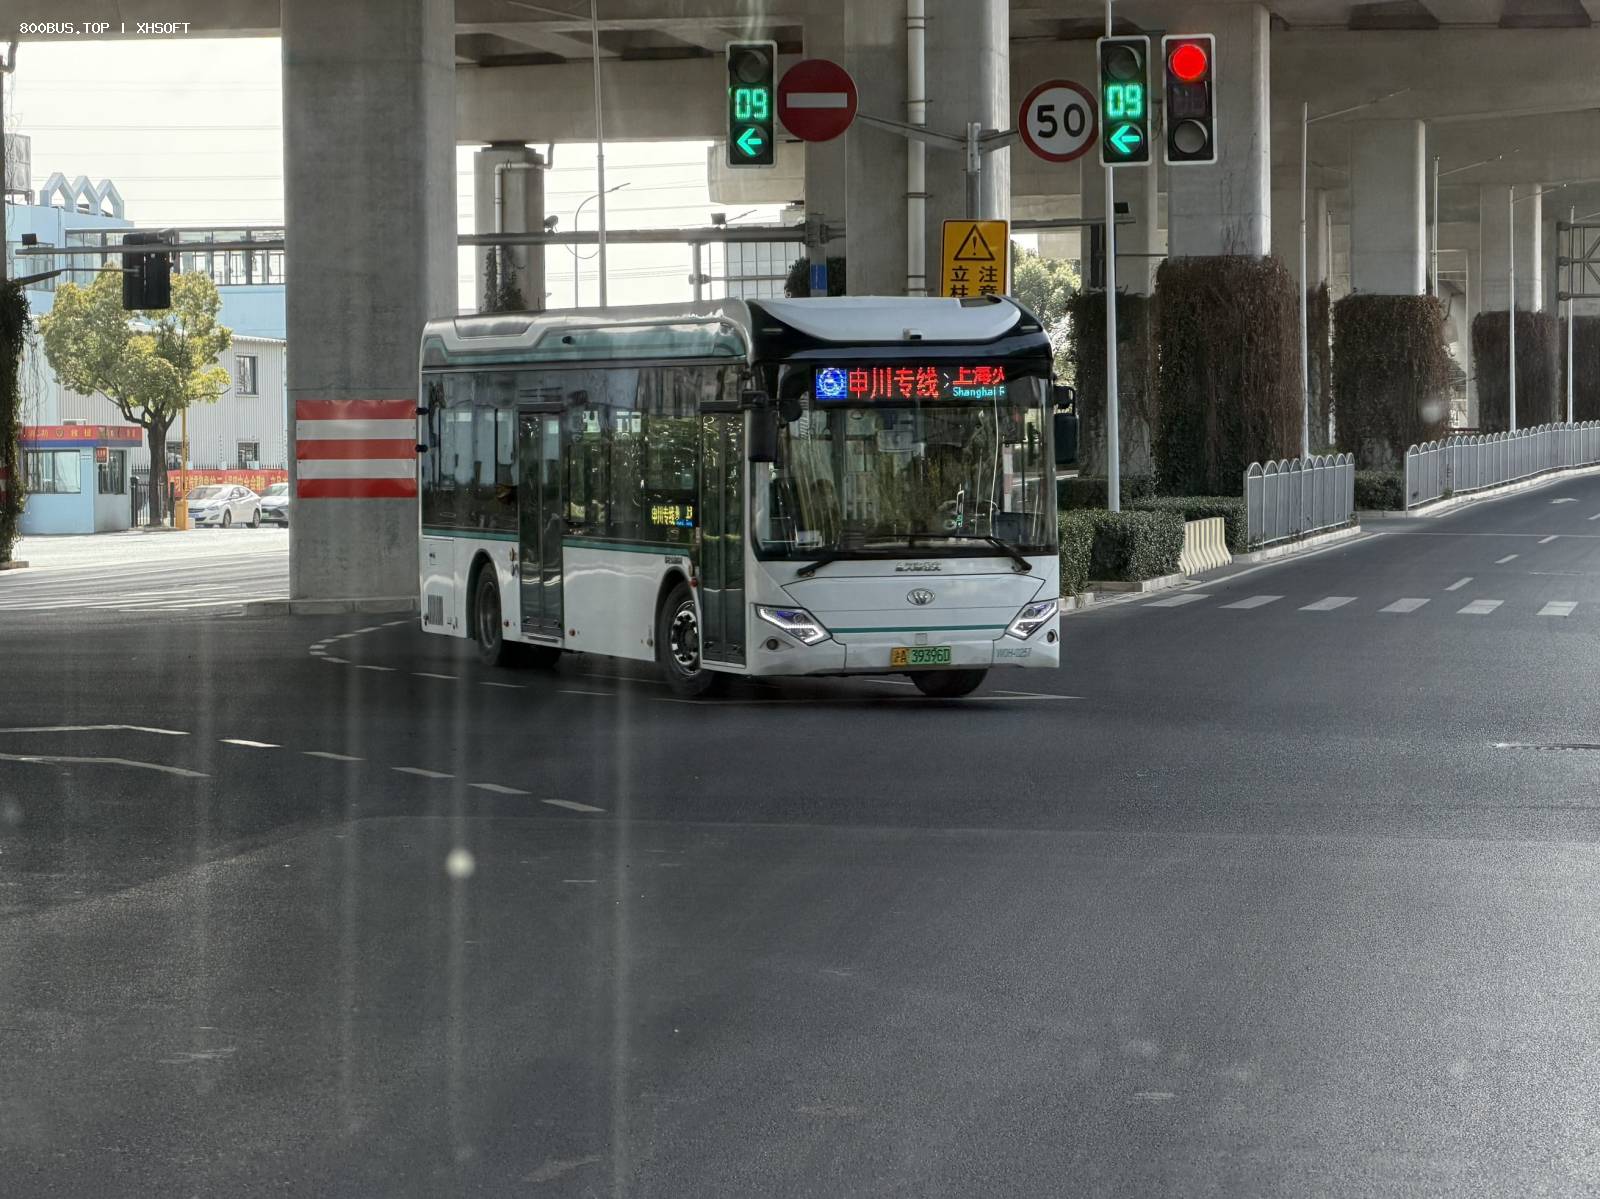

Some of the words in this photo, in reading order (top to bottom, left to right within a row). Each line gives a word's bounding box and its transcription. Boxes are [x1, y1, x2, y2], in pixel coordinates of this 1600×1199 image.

[736, 88, 767, 119] 09
[1107, 84, 1142, 118] 09
[1037, 103, 1086, 139] 50
[849, 367, 940, 399] 申川专线
[952, 386, 996, 400] Shanghai
